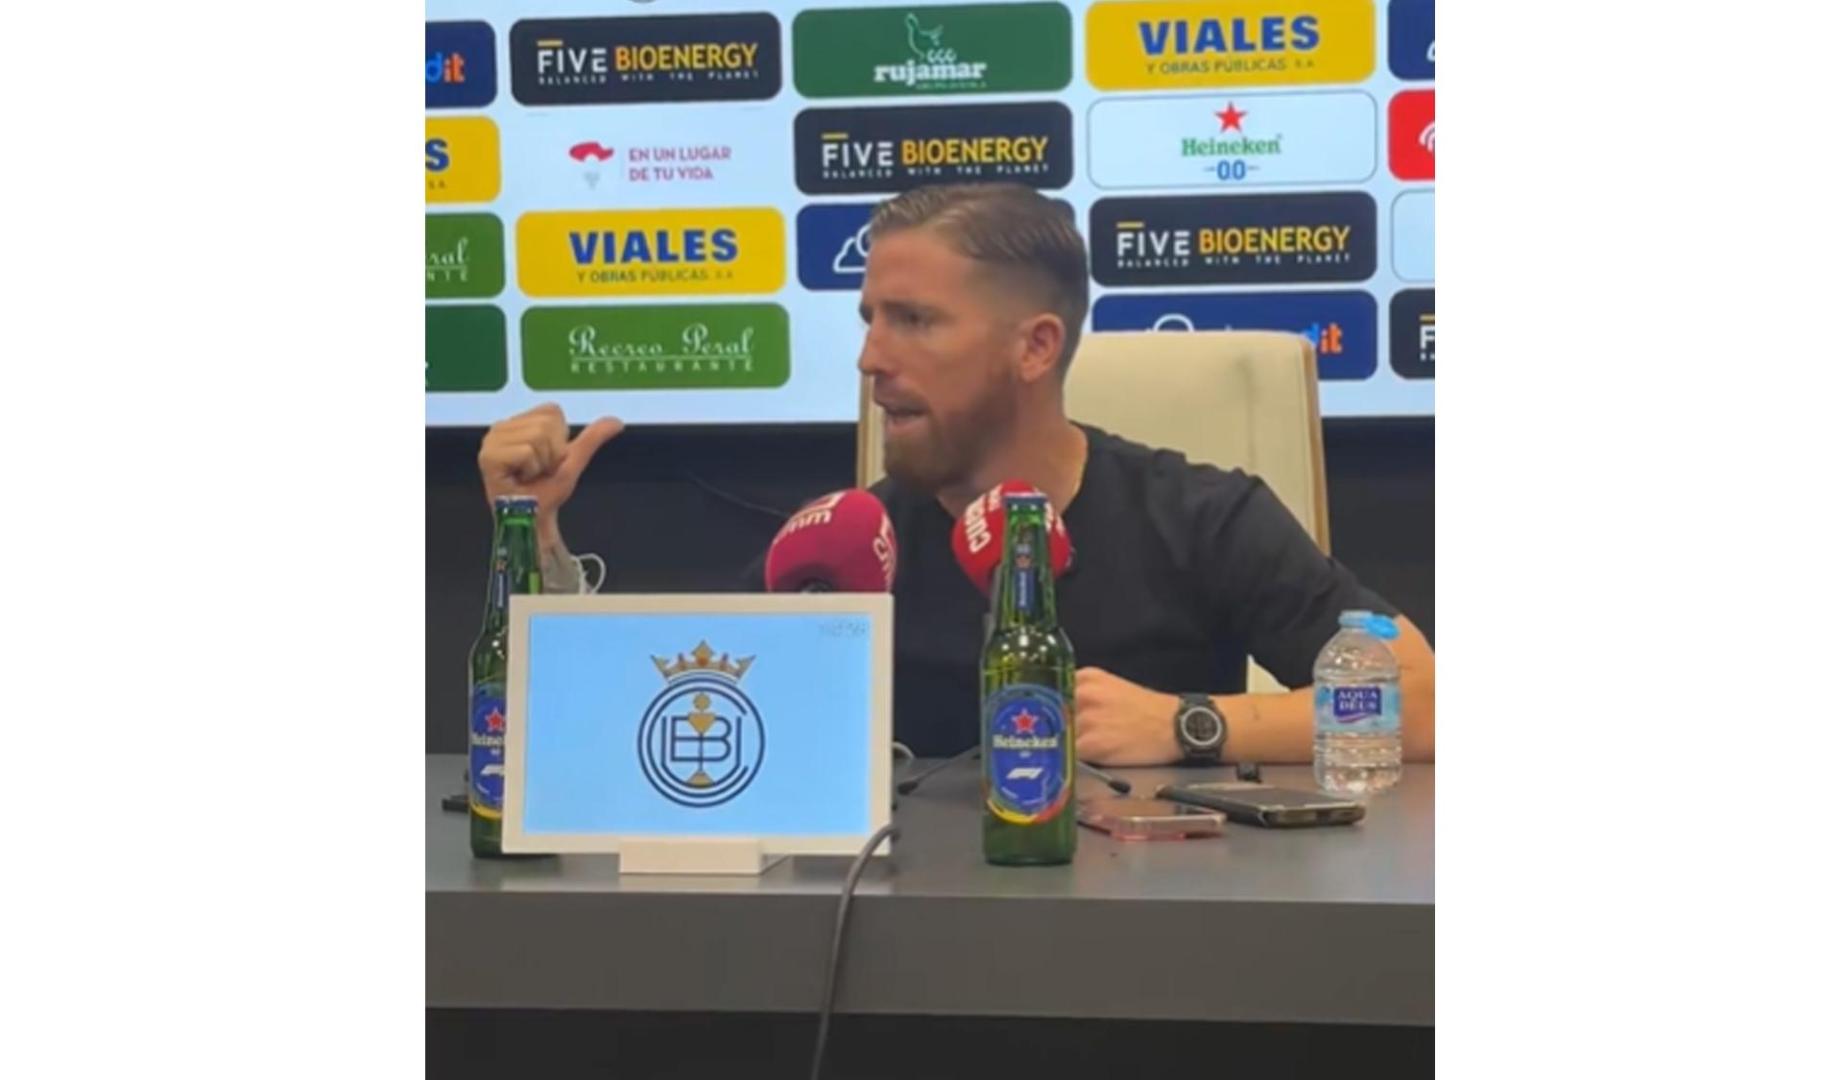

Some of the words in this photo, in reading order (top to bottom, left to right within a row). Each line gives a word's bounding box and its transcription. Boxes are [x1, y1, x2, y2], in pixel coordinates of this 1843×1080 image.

[1138, 16, 1320, 55] VIALES
[538, 48, 607, 74] FIVE
[614, 42, 758, 71] BIOENERGY
[874, 59, 987, 86] rujamar
[1160, 61, 1209, 74] OBRAS
[629, 147, 650, 161] EN
[653, 146, 676, 161] UN
[679, 145, 732, 160] LUGAR
[822, 142, 894, 168] FIVE
[901, 136, 1049, 165] BIOENERGY
[1181, 137, 1281, 156] Heineken
[629, 167, 650, 181] DE
[653, 166, 674, 181] TU
[677, 165, 714, 180] VIDA
[569, 229, 739, 265] VIALES
[1117, 231, 1190, 257] FIVE
[1199, 226, 1350, 254] BIOENERGY
[590, 270, 637, 283] OBRAS
[570, 360, 754, 374] RESTAURANTE
[1338, 690, 1378, 700] AQUA
[1339, 701, 1377, 711] DEUS
